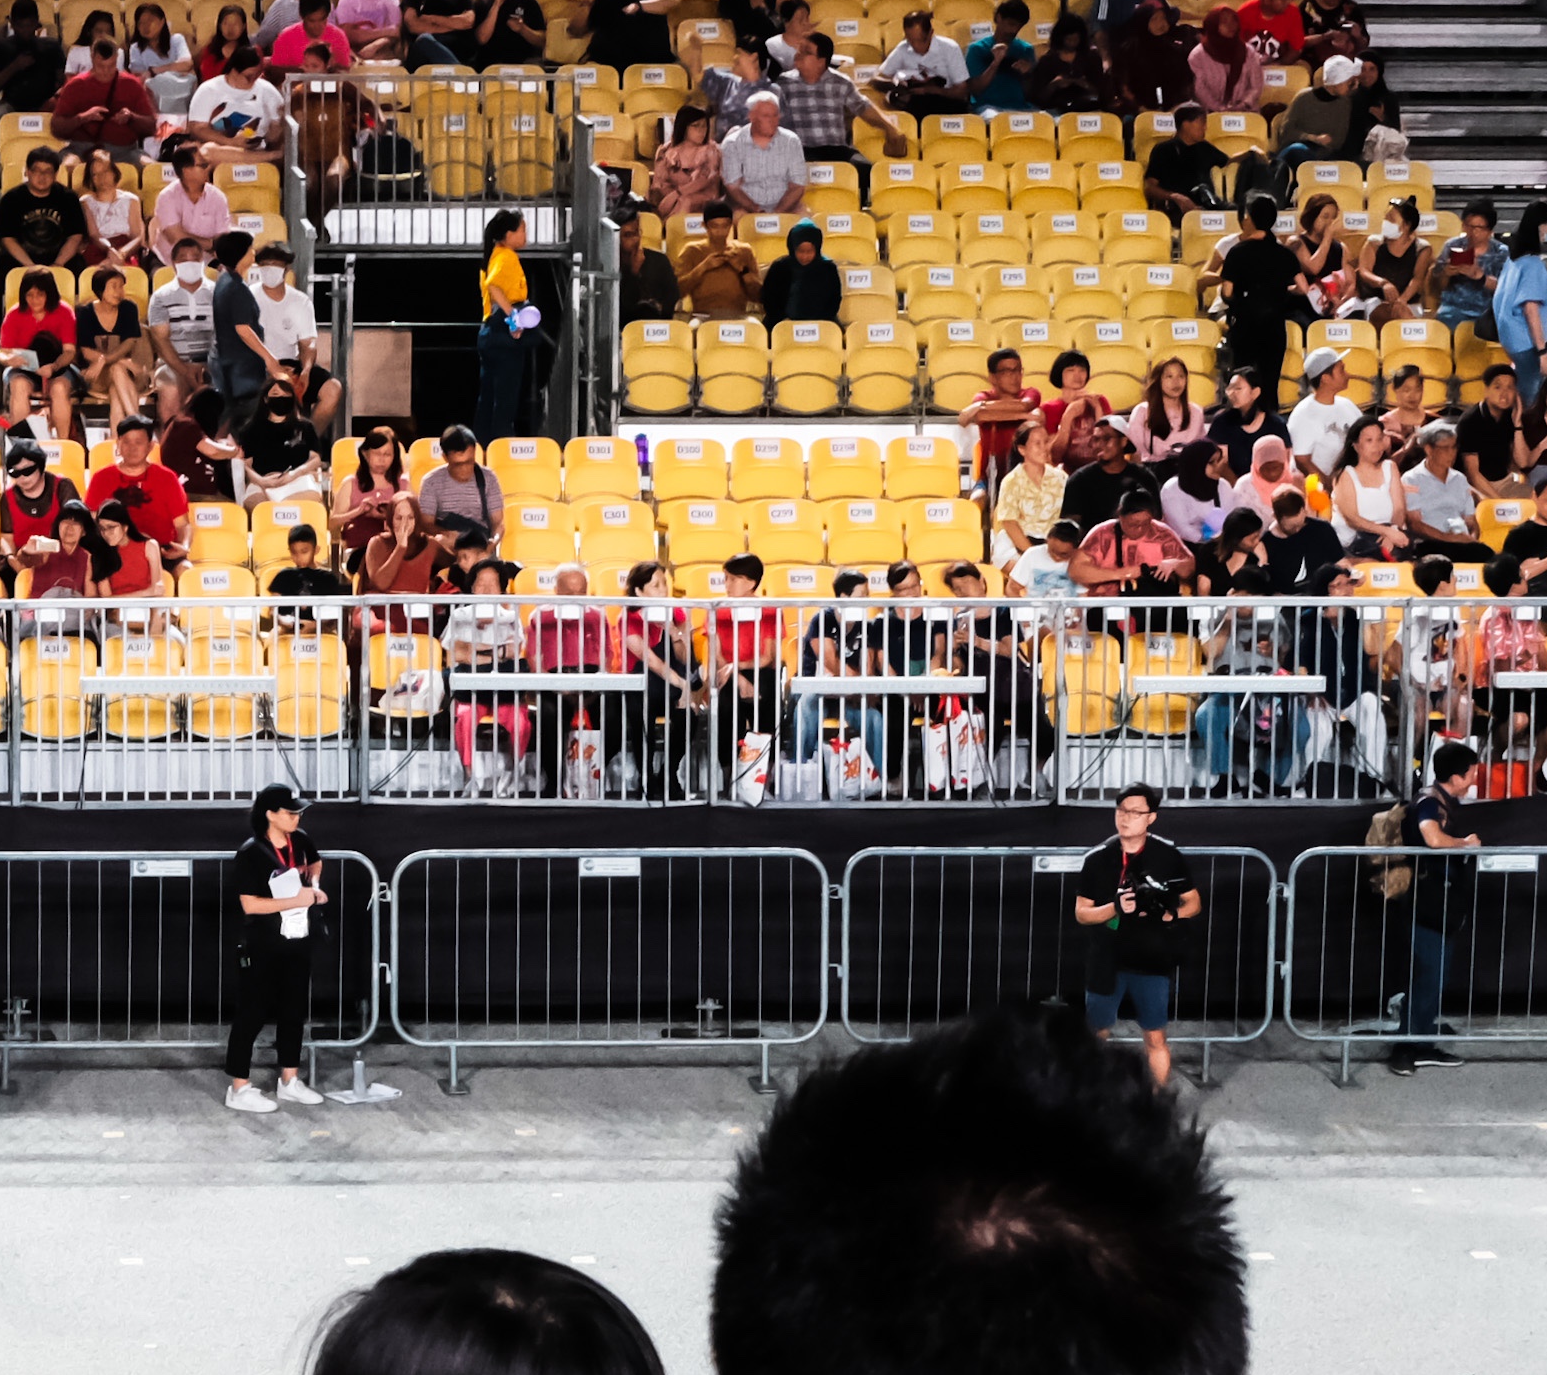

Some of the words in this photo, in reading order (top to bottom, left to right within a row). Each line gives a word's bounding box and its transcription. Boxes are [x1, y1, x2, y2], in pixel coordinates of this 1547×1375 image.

[930, 272, 951, 281] F296
[869, 328, 891, 338] E297
[1024, 327, 1046, 337] E295
[1098, 328, 1120, 336] E294
[511, 446, 535, 455] D302
[588, 445, 611, 454] D301
[274, 511, 298, 521] C305
[523, 512, 546, 522] C302
[604, 510, 627, 520] C301
[690, 509, 714, 519] C300
[927, 507, 950, 518] C297
